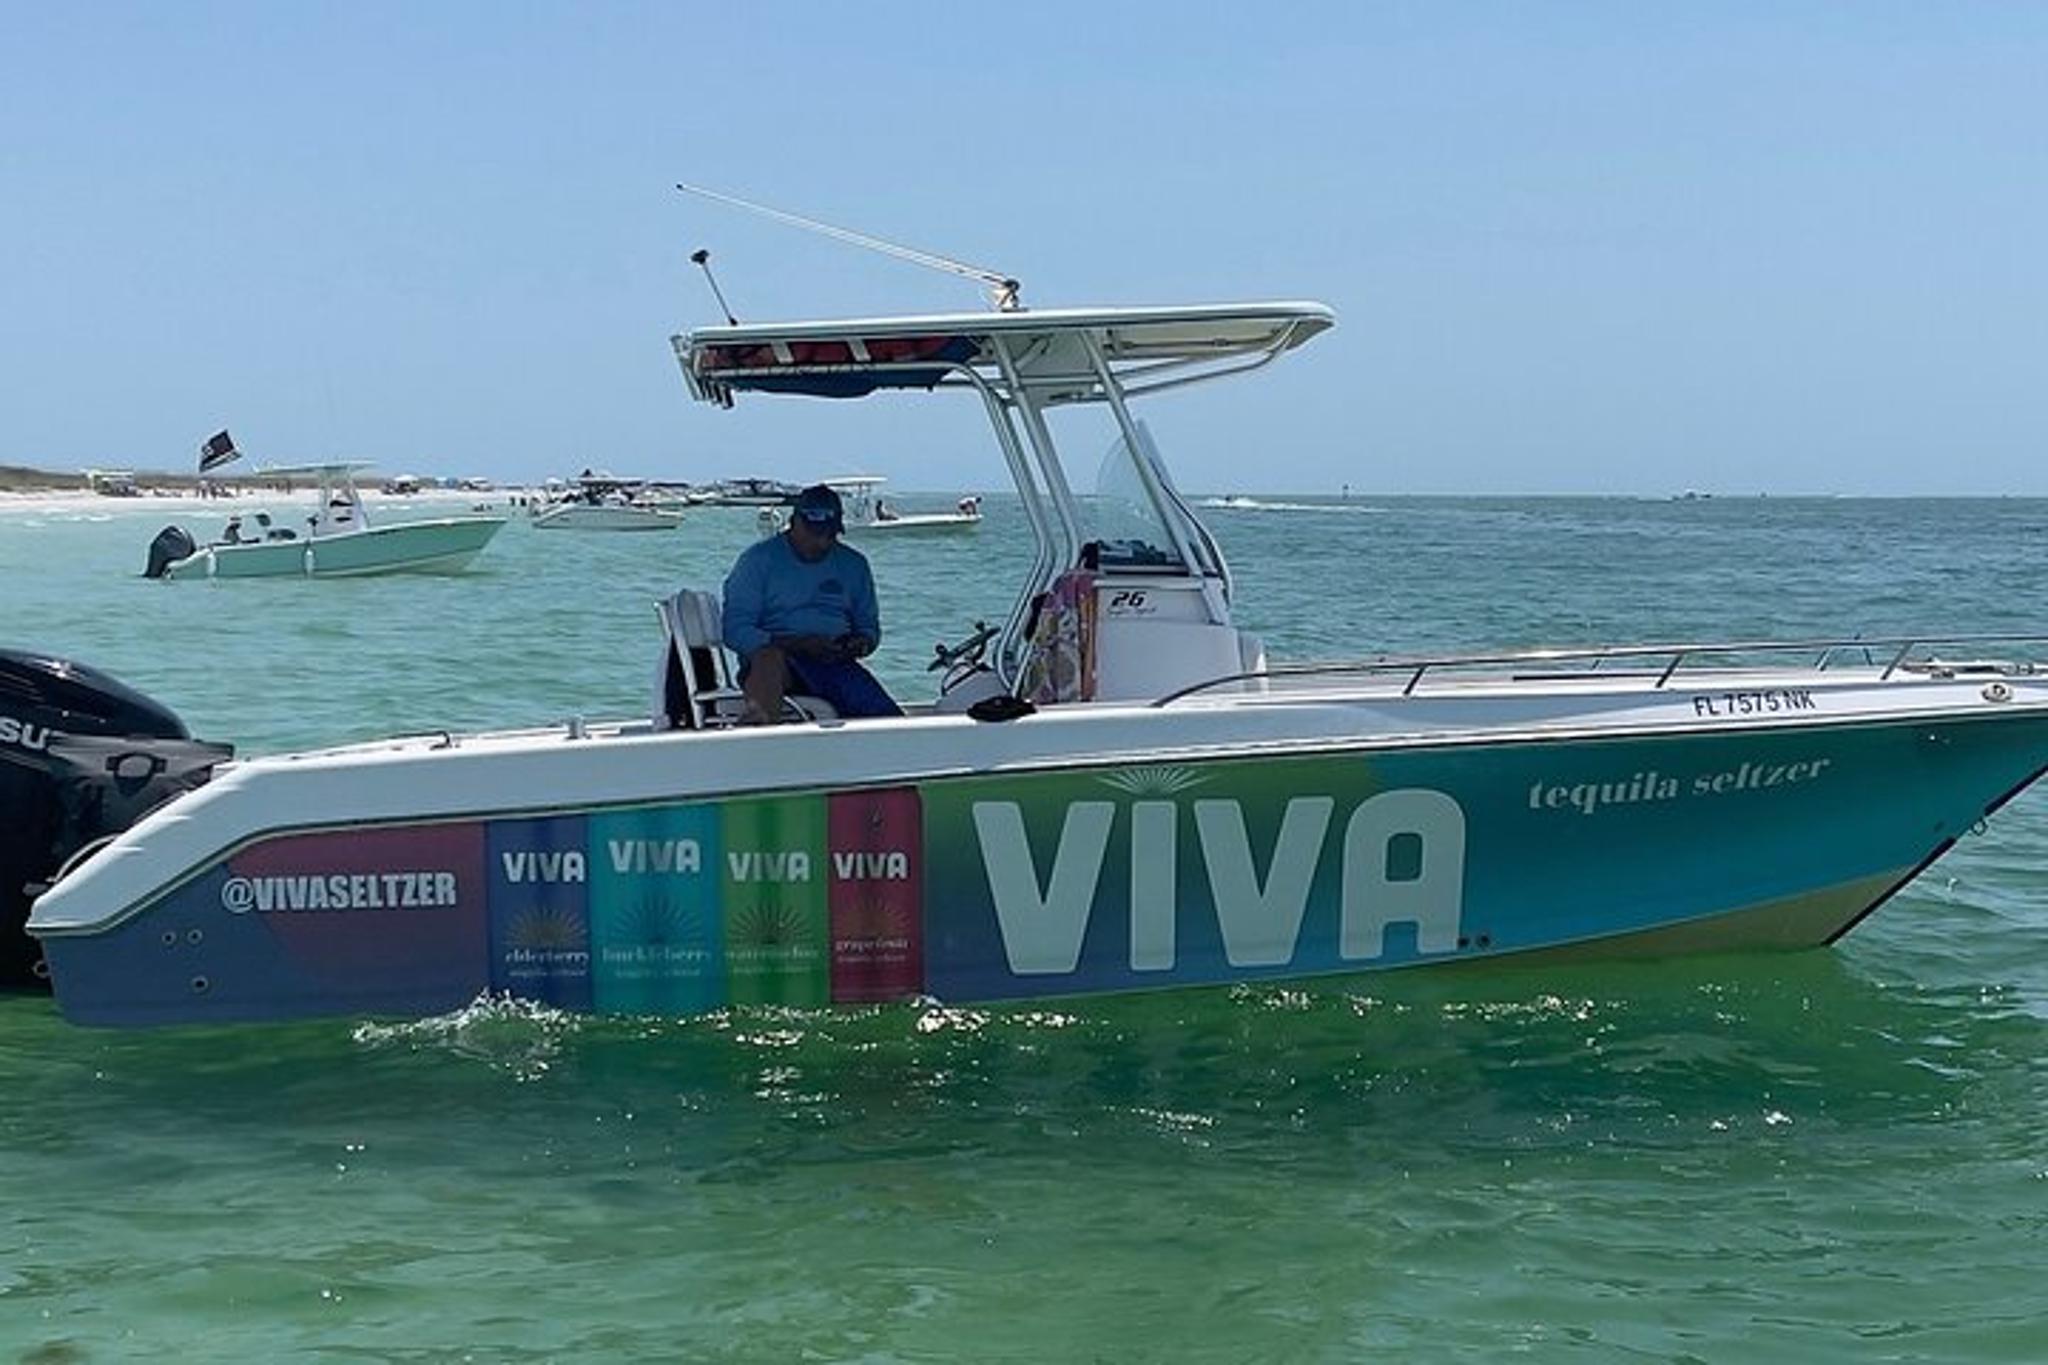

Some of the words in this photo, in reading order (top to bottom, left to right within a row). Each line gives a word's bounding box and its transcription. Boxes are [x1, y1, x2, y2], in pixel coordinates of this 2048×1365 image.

[1111, 591, 1146, 607] 26
[1693, 696, 1720, 717] FL
[1723, 691, 1779, 714] 7575
[1783, 689, 1816, 709] NK
[1529, 771, 1679, 814] tequila
[1692, 758, 1831, 795] seltzer
[502, 852, 585, 882] VIVA
[608, 839, 701, 872] VIVA
[727, 852, 809, 882] VIVA
[833, 852, 908, 879] VIVA
[221, 872, 457, 913] @VIVASELTZER
[972, 788, 1466, 975] VIVA
